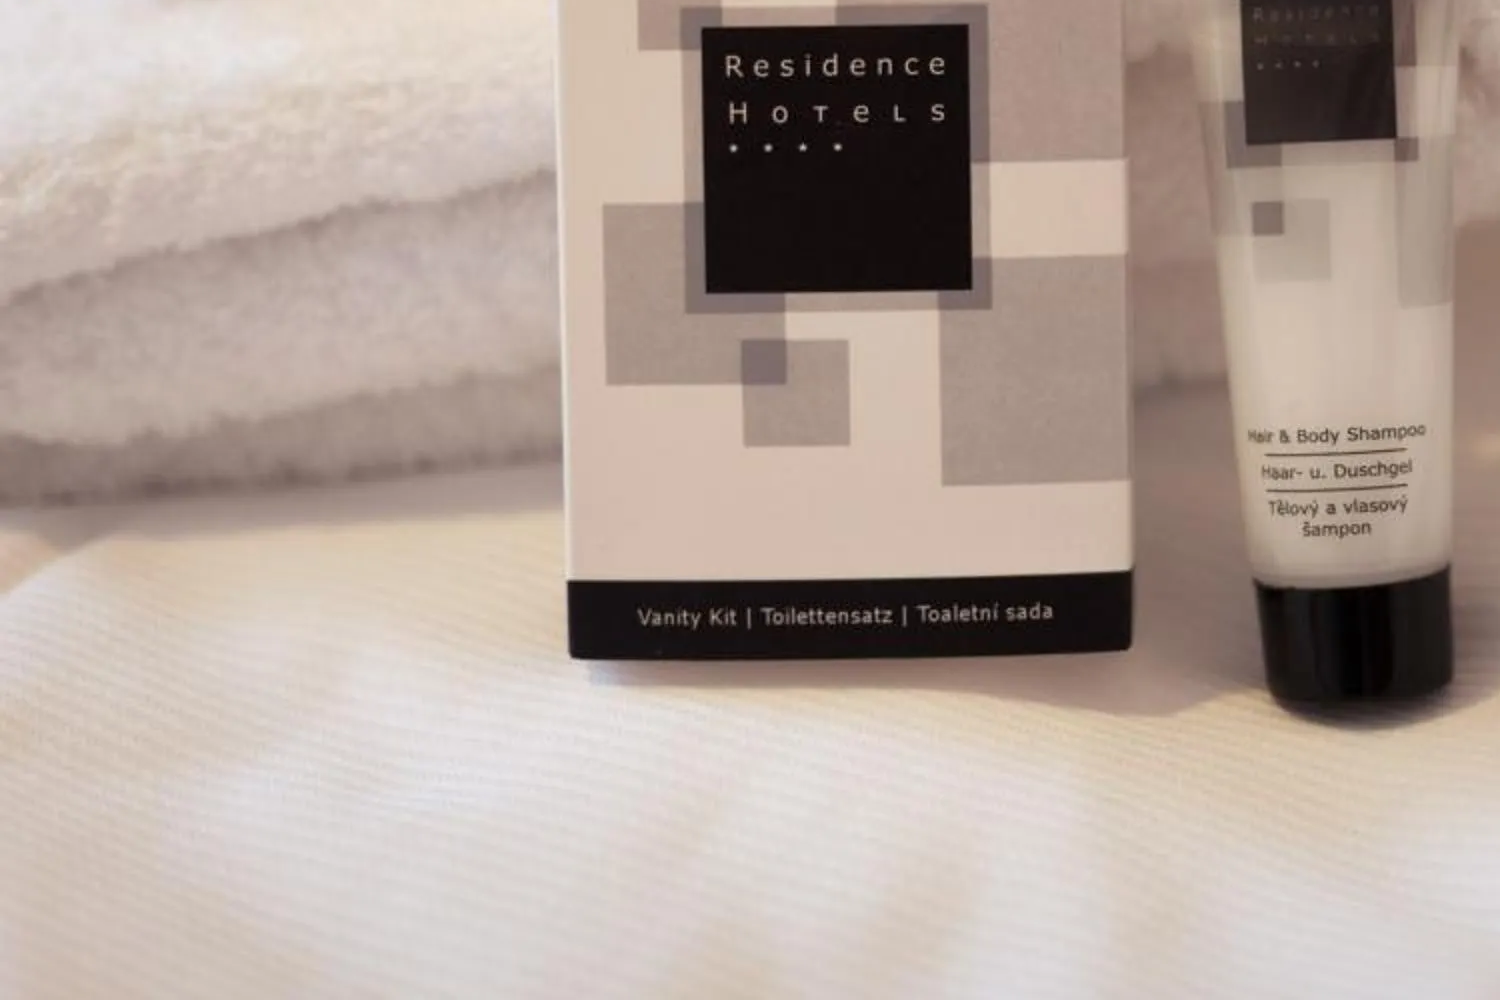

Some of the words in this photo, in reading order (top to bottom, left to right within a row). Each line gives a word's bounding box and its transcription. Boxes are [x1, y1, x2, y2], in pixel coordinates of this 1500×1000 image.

[725, 53, 946, 78] Residence
[1248, 429, 1274, 444] Hair
[1279, 429, 1291, 443] &
[1297, 427, 1340, 445] Body
[1347, 424, 1427, 442] Shampoo
[1261, 464, 1303, 481] Haar-
[1309, 467, 1327, 479] u.
[1333, 459, 1413, 479] Duschgel
[1325, 503, 1336, 515] a
[1343, 495, 1408, 514] vlasový
[1302, 520, 1372, 539] šampon
[638, 608, 701, 630] Vanity
[708, 608, 738, 627] Kit
[760, 605, 893, 627] Toilettensatz
[916, 601, 1000, 624] Toaletní
[1005, 602, 1054, 621] sada
